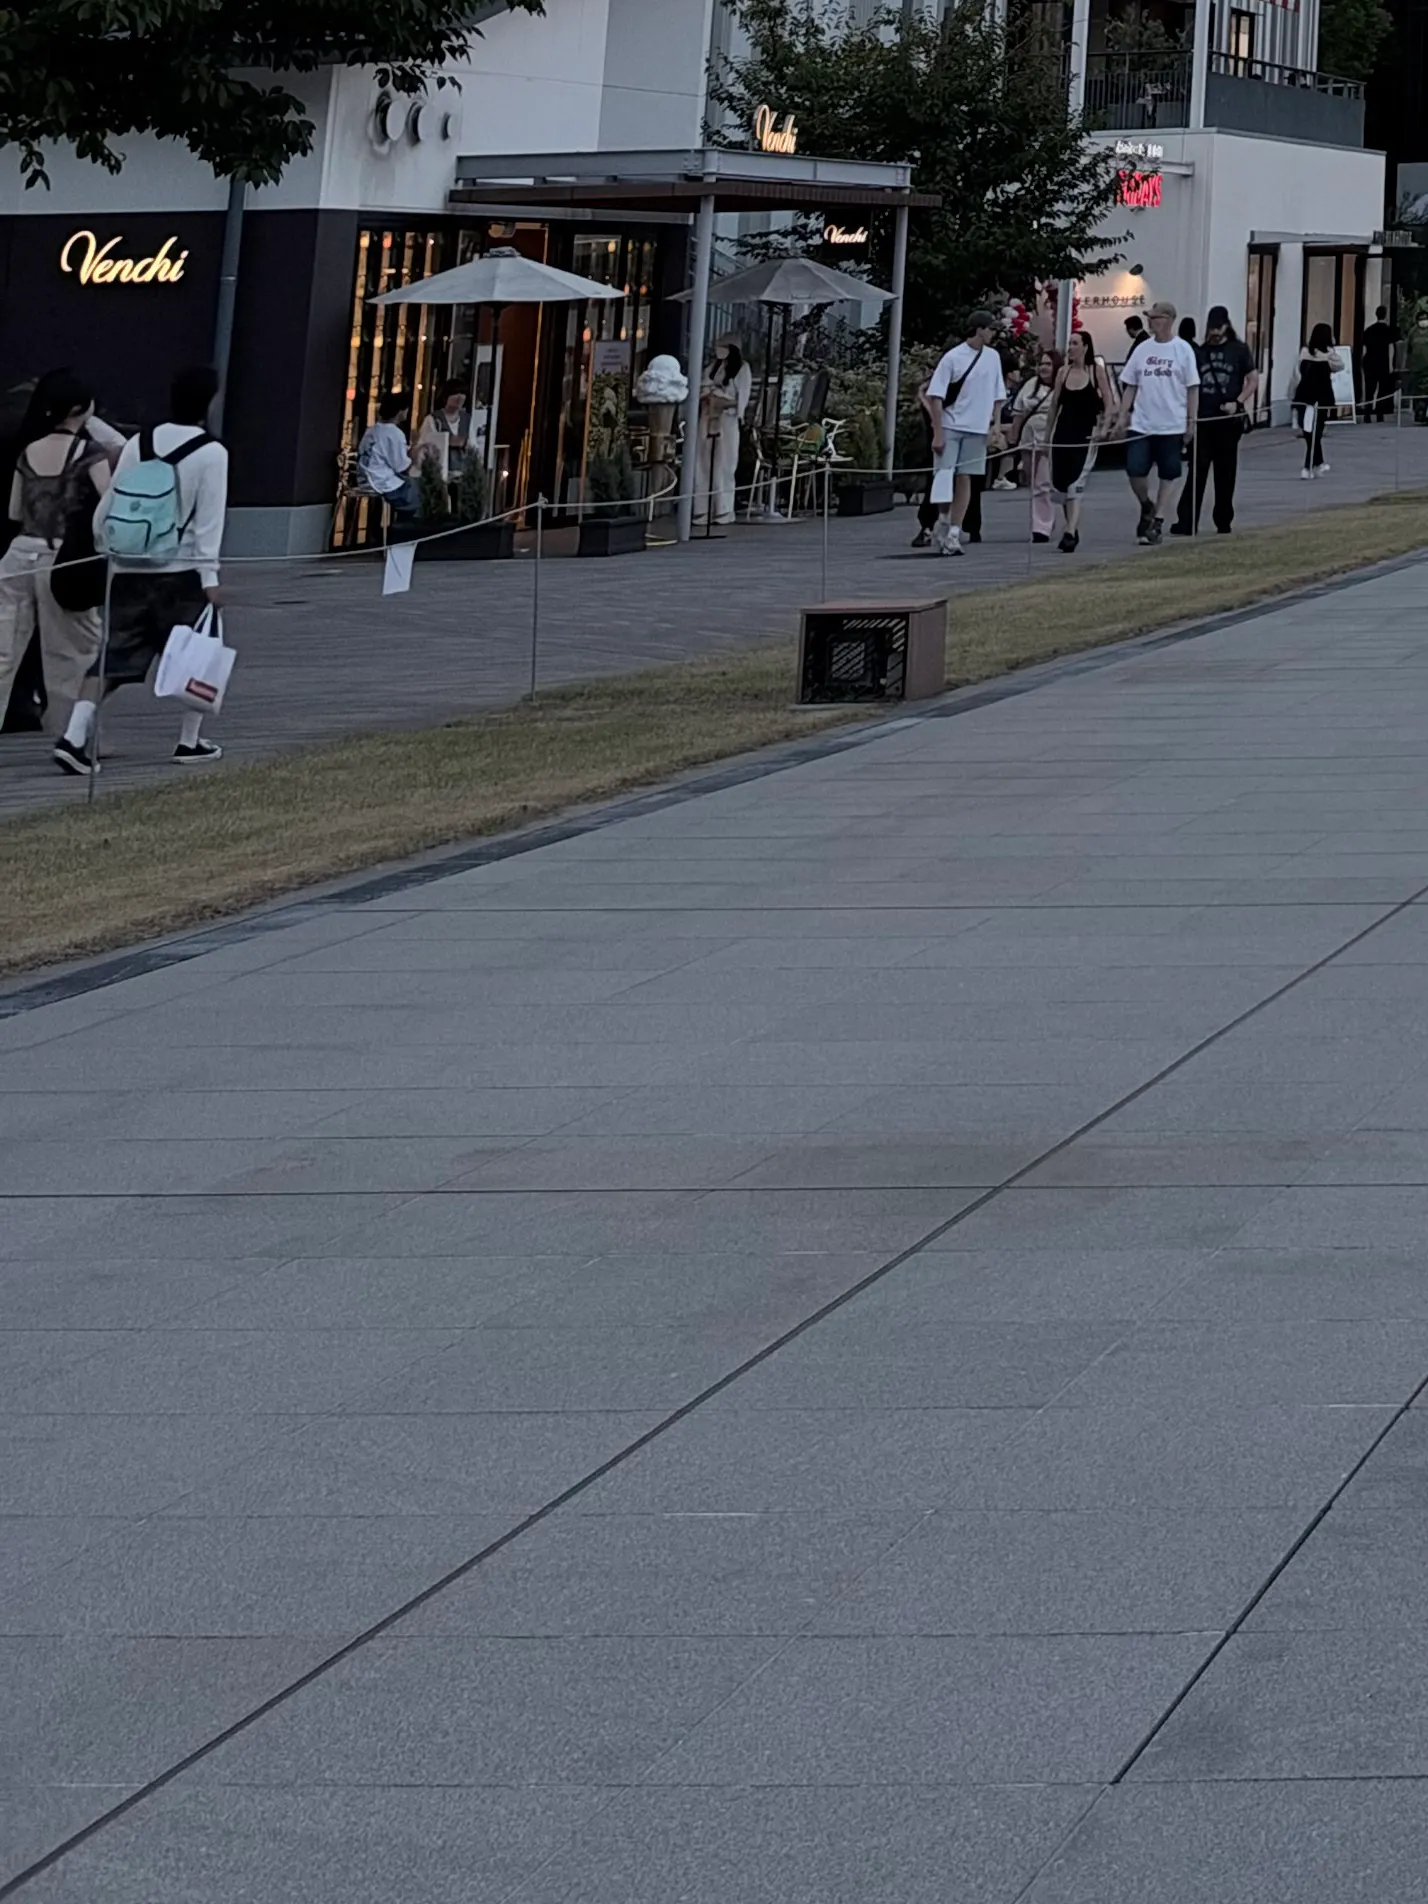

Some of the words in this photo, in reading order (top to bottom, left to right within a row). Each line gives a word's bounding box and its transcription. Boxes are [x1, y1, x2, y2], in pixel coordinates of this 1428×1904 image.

[755, 104, 799, 154] Venchi
[823, 224, 869, 244] Venchi
[60, 230, 190, 286] Venchi
[1078, 295, 1145, 306] ERHOUSE
[1143, 368, 1153, 377] to
